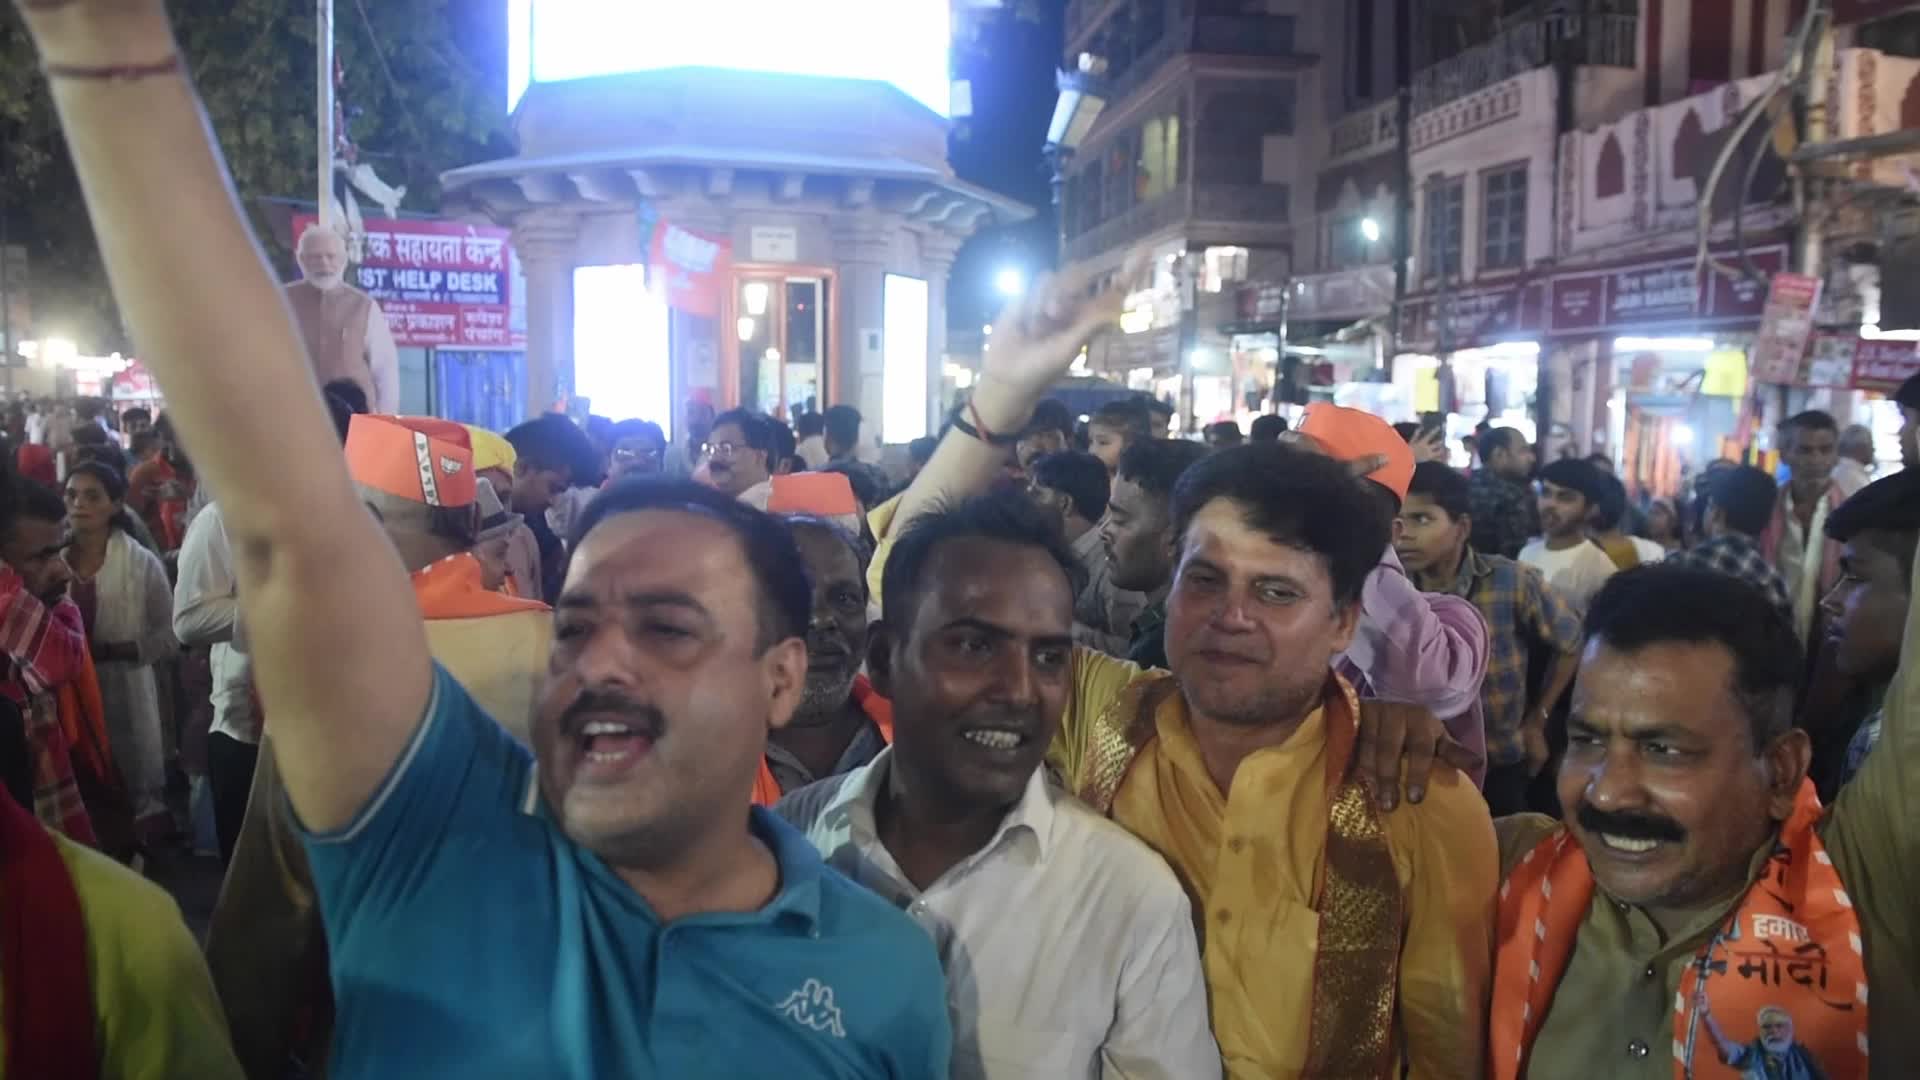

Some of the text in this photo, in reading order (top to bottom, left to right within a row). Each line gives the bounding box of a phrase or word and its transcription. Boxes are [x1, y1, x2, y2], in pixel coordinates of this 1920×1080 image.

[393, 233, 461, 267] सहायता
[392, 269, 442, 289] HELP
[447, 271, 497, 292] DESK
[1735, 939, 1830, 990] मोदी
